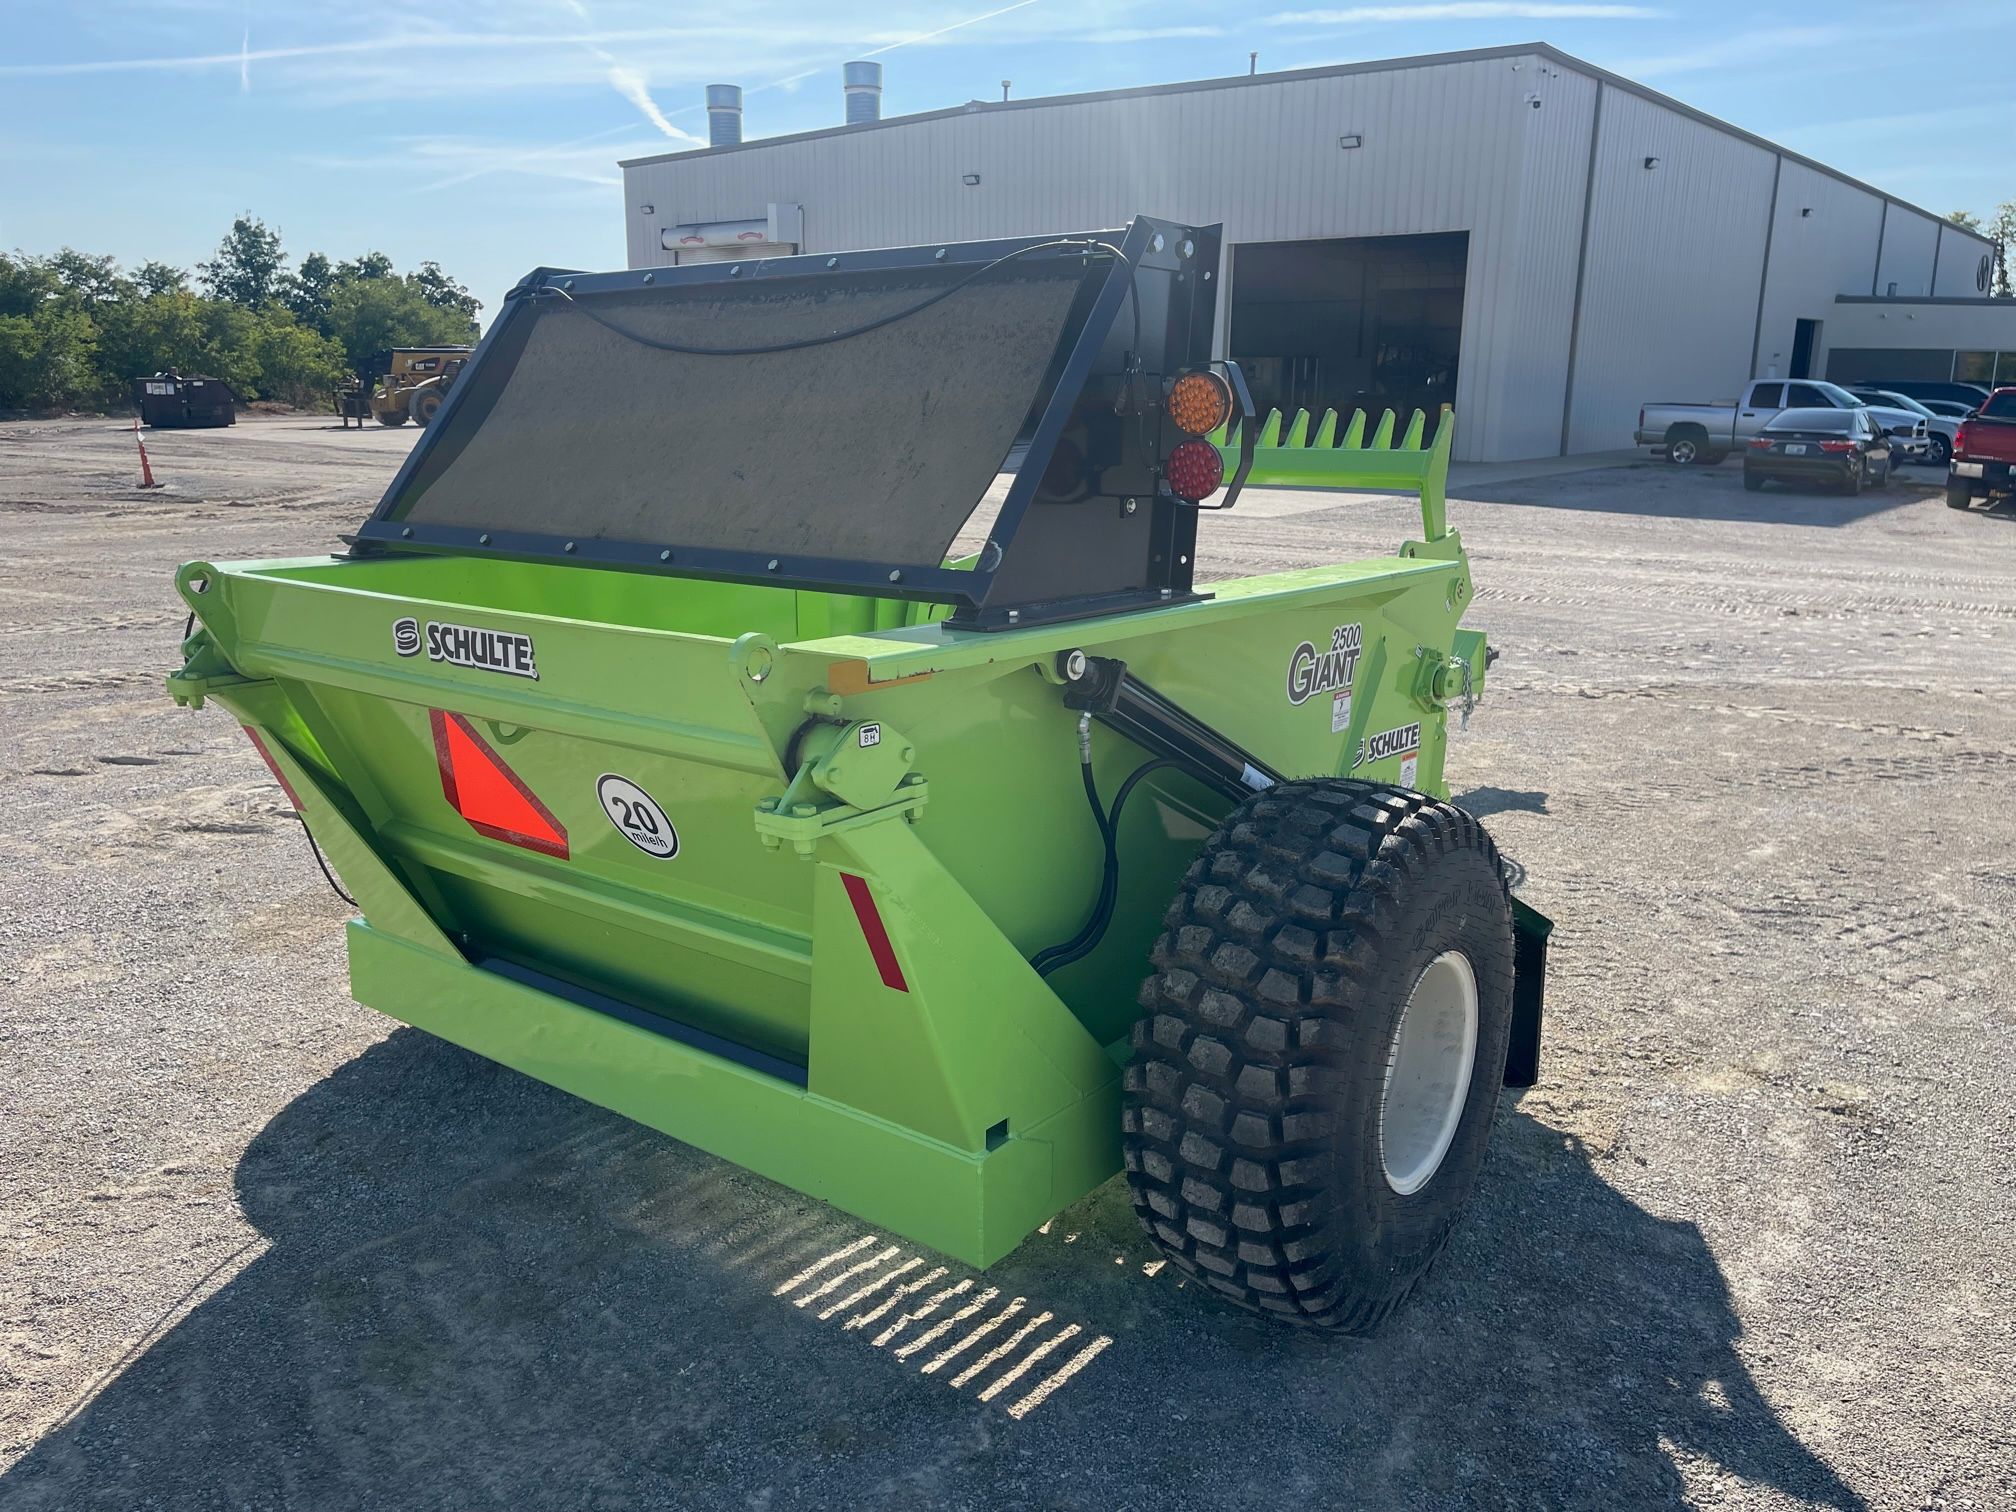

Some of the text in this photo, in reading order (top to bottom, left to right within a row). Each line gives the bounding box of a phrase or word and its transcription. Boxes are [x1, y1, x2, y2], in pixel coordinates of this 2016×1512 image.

[427, 624, 531, 672] SCHULTE
[1331, 624, 1361, 652] 2500
[1288, 643, 1361, 702] GIANT
[1368, 723, 1419, 760] SCHULTE
[611, 796, 659, 835] 20
[631, 831, 669, 849] mile/h
